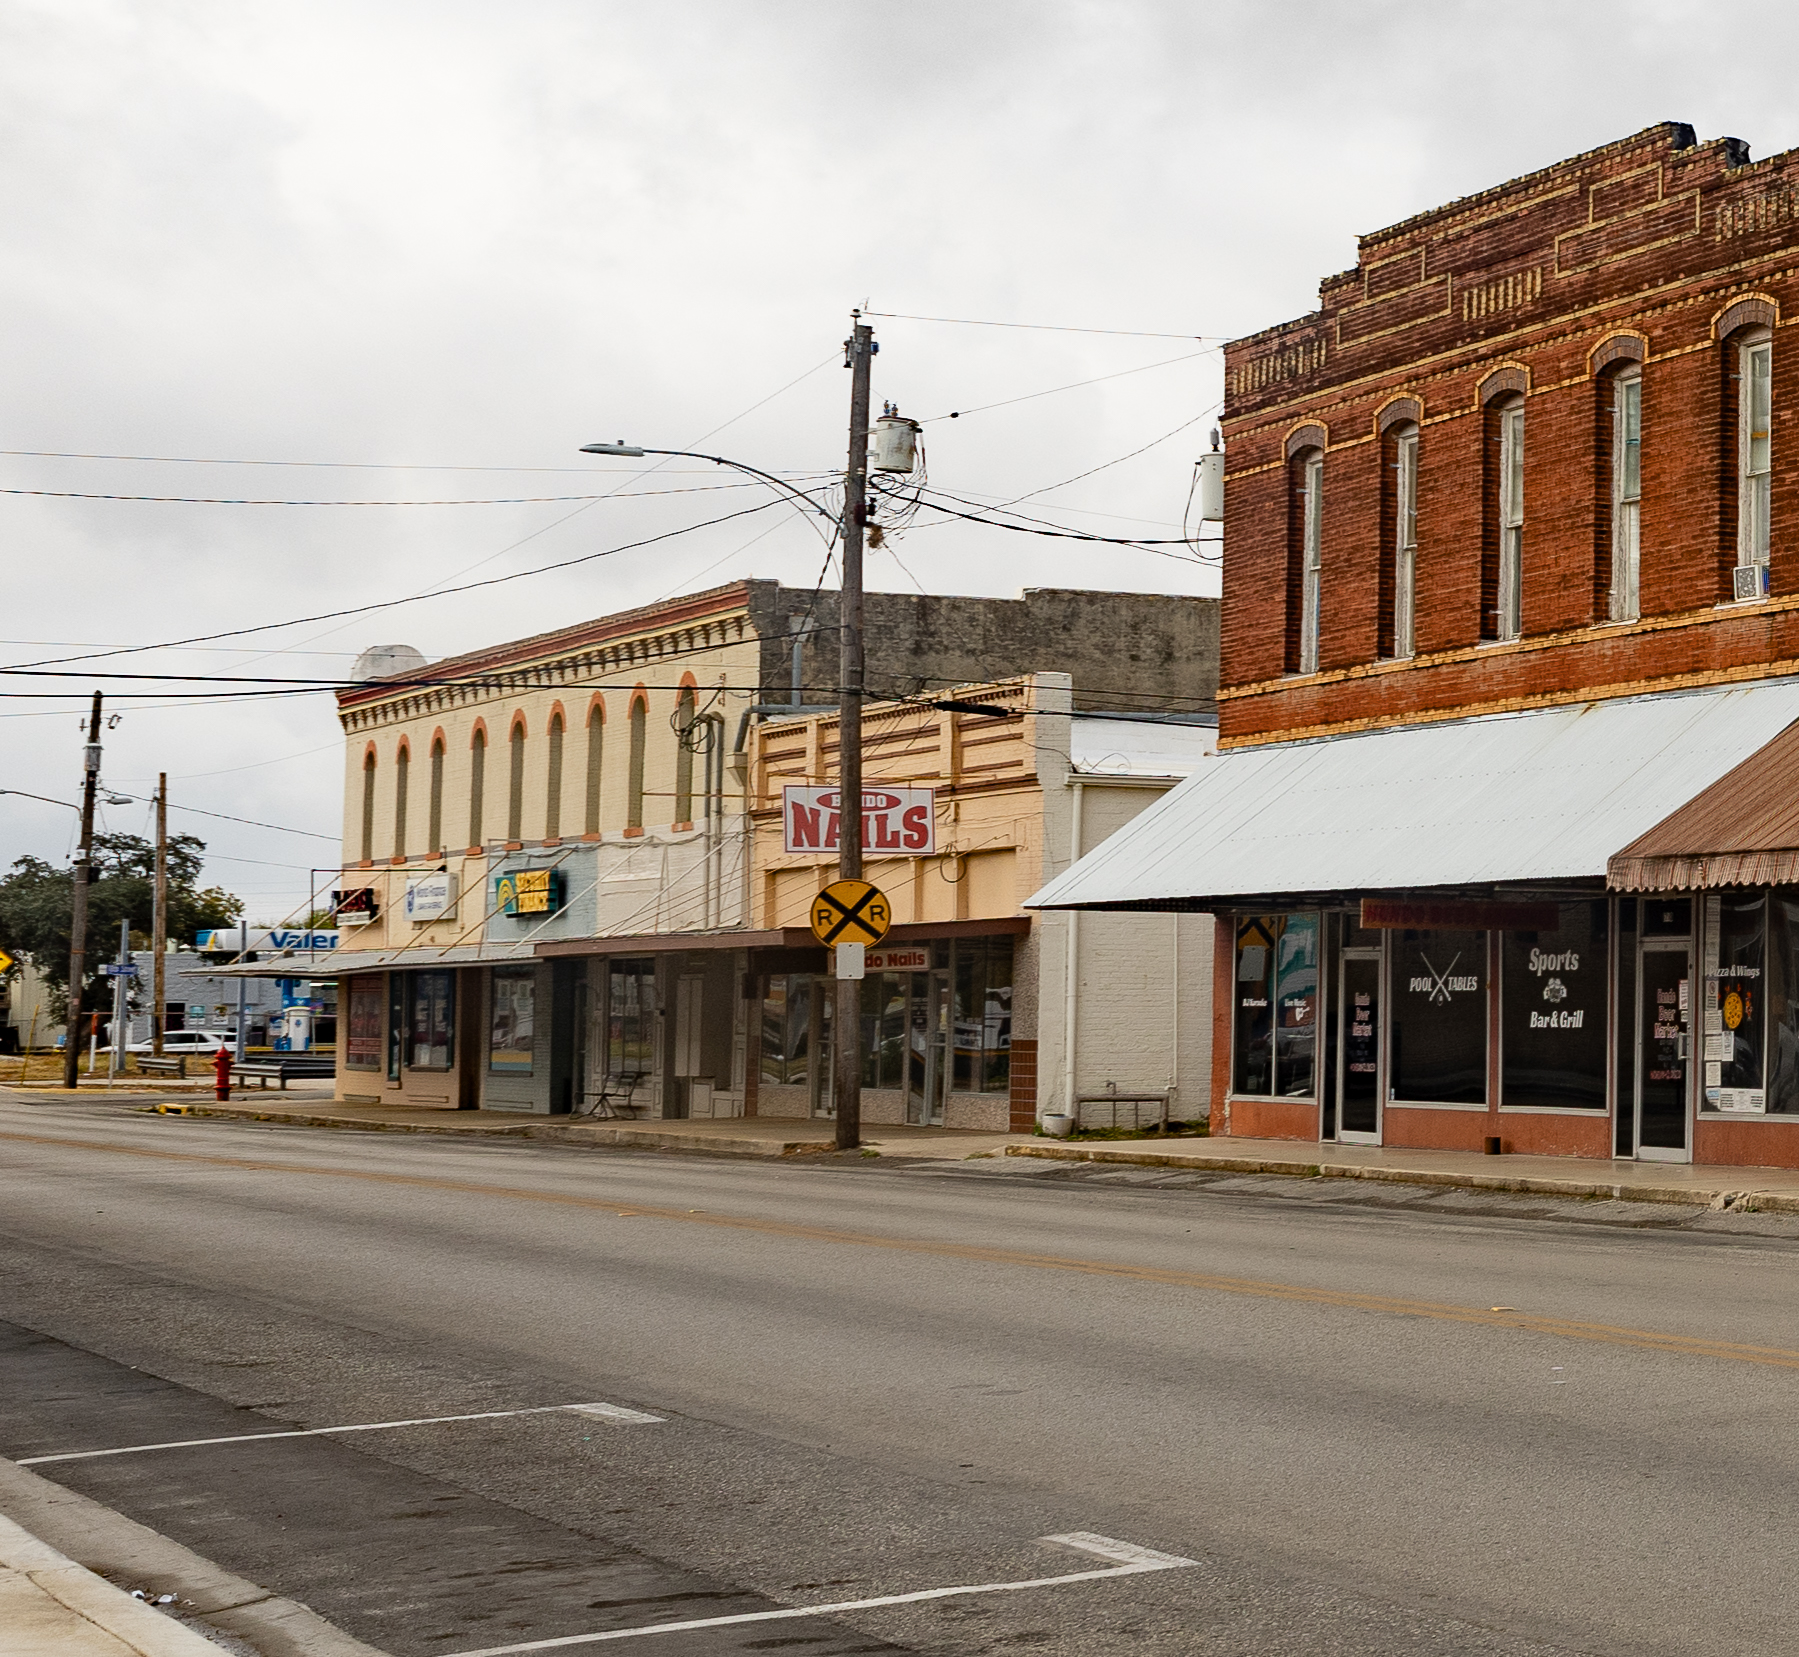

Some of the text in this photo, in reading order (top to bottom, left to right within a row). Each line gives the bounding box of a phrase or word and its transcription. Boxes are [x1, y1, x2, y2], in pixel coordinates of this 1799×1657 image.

[831, 795, 888, 807] HDO
[817, 909, 834, 926] R
[869, 905, 886, 922] R
[887, 952, 926, 967] Nails
[1528, 947, 1580, 977] Sports
[1730, 964, 1737, 977] &
[1737, 965, 1760, 979] Wings
[1409, 976, 1479, 992] POOL TABLES
[1560, 1010, 1584, 1028] Grill
